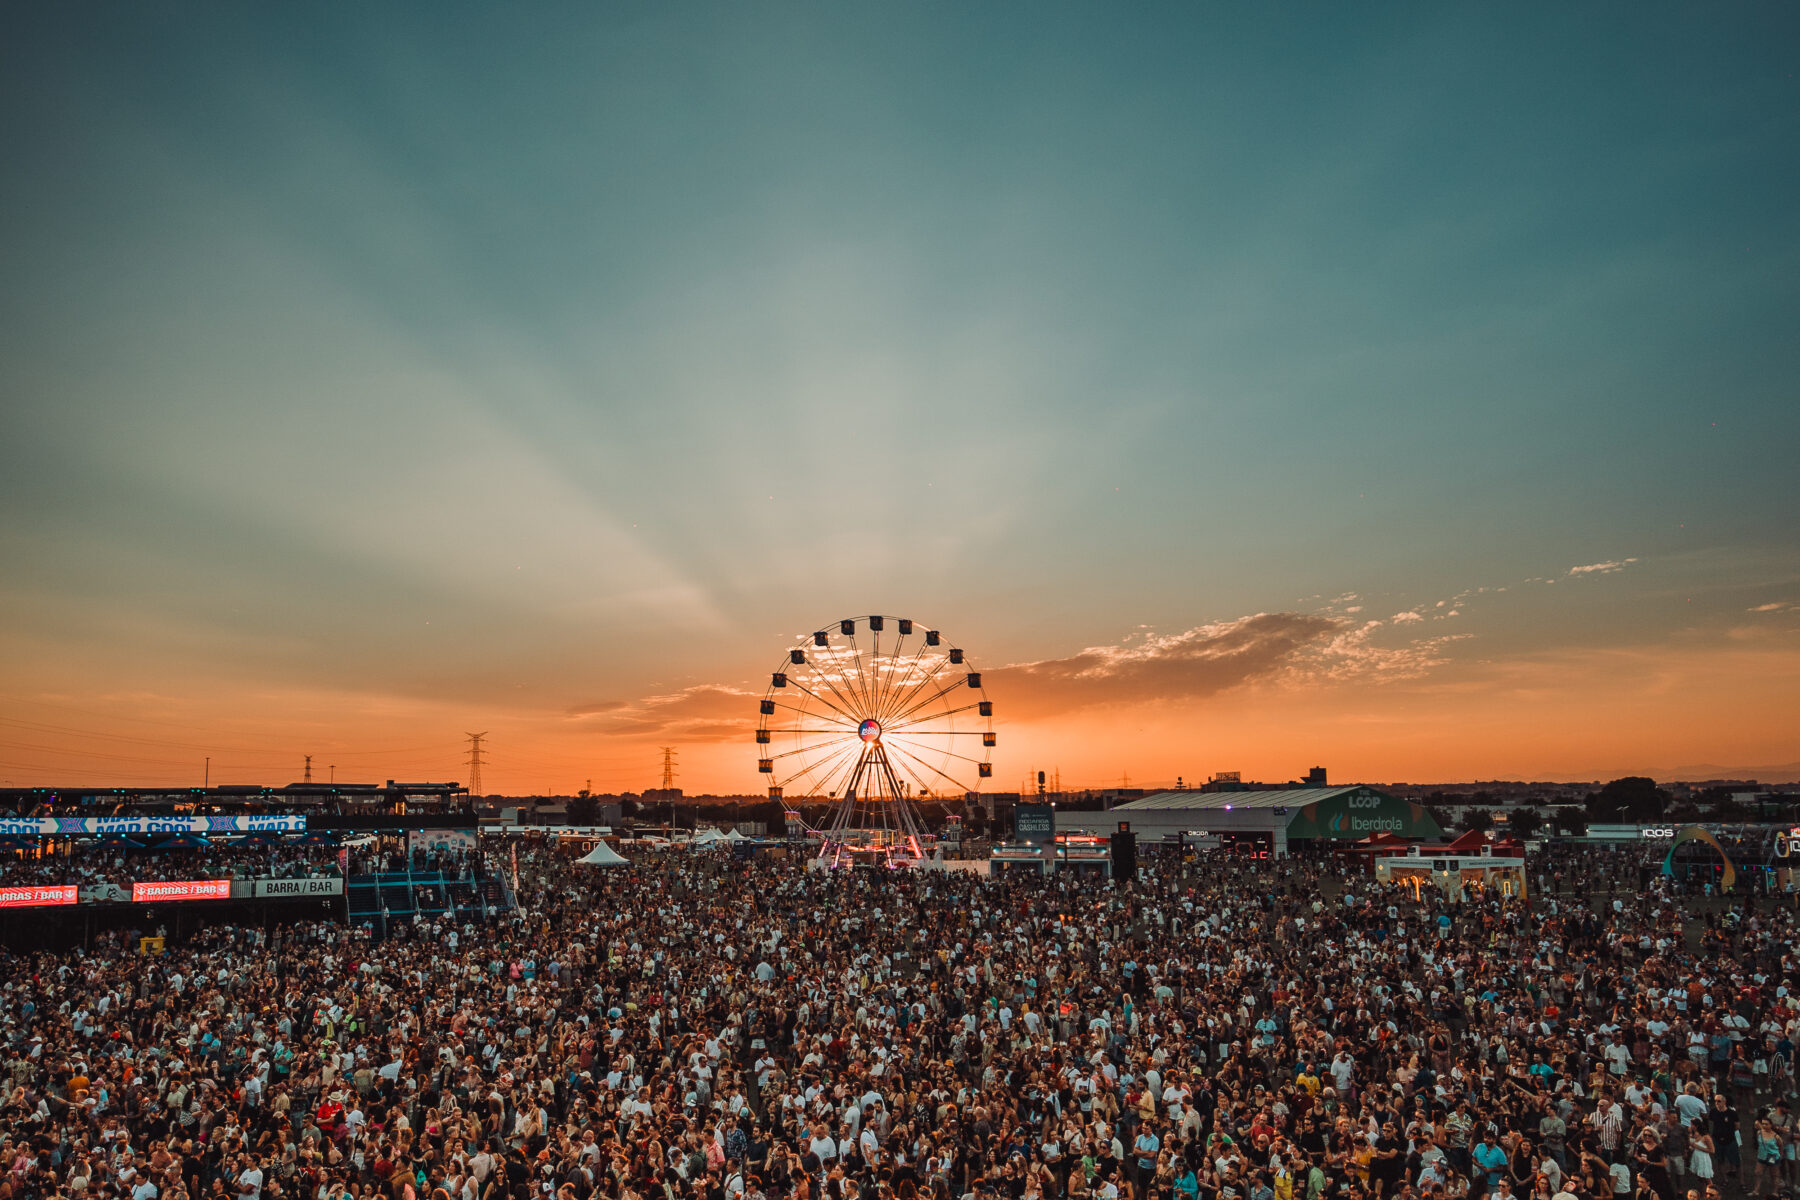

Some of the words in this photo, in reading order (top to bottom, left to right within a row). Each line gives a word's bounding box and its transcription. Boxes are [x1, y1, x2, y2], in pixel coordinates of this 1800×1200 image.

[1348, 796, 1380, 808] LOOP
[1351, 816, 1403, 830] Iberdrola
[1642, 829, 1674, 838] IQOS
[147, 886, 188, 896] BARRAS
[196, 885, 217, 894] BAR
[266, 882, 300, 894] BARRA
[302, 881, 307, 893] /
[310, 881, 333, 892] BAR
[0, 892, 32, 901] RRAS
[40, 891, 63, 900] BAR
